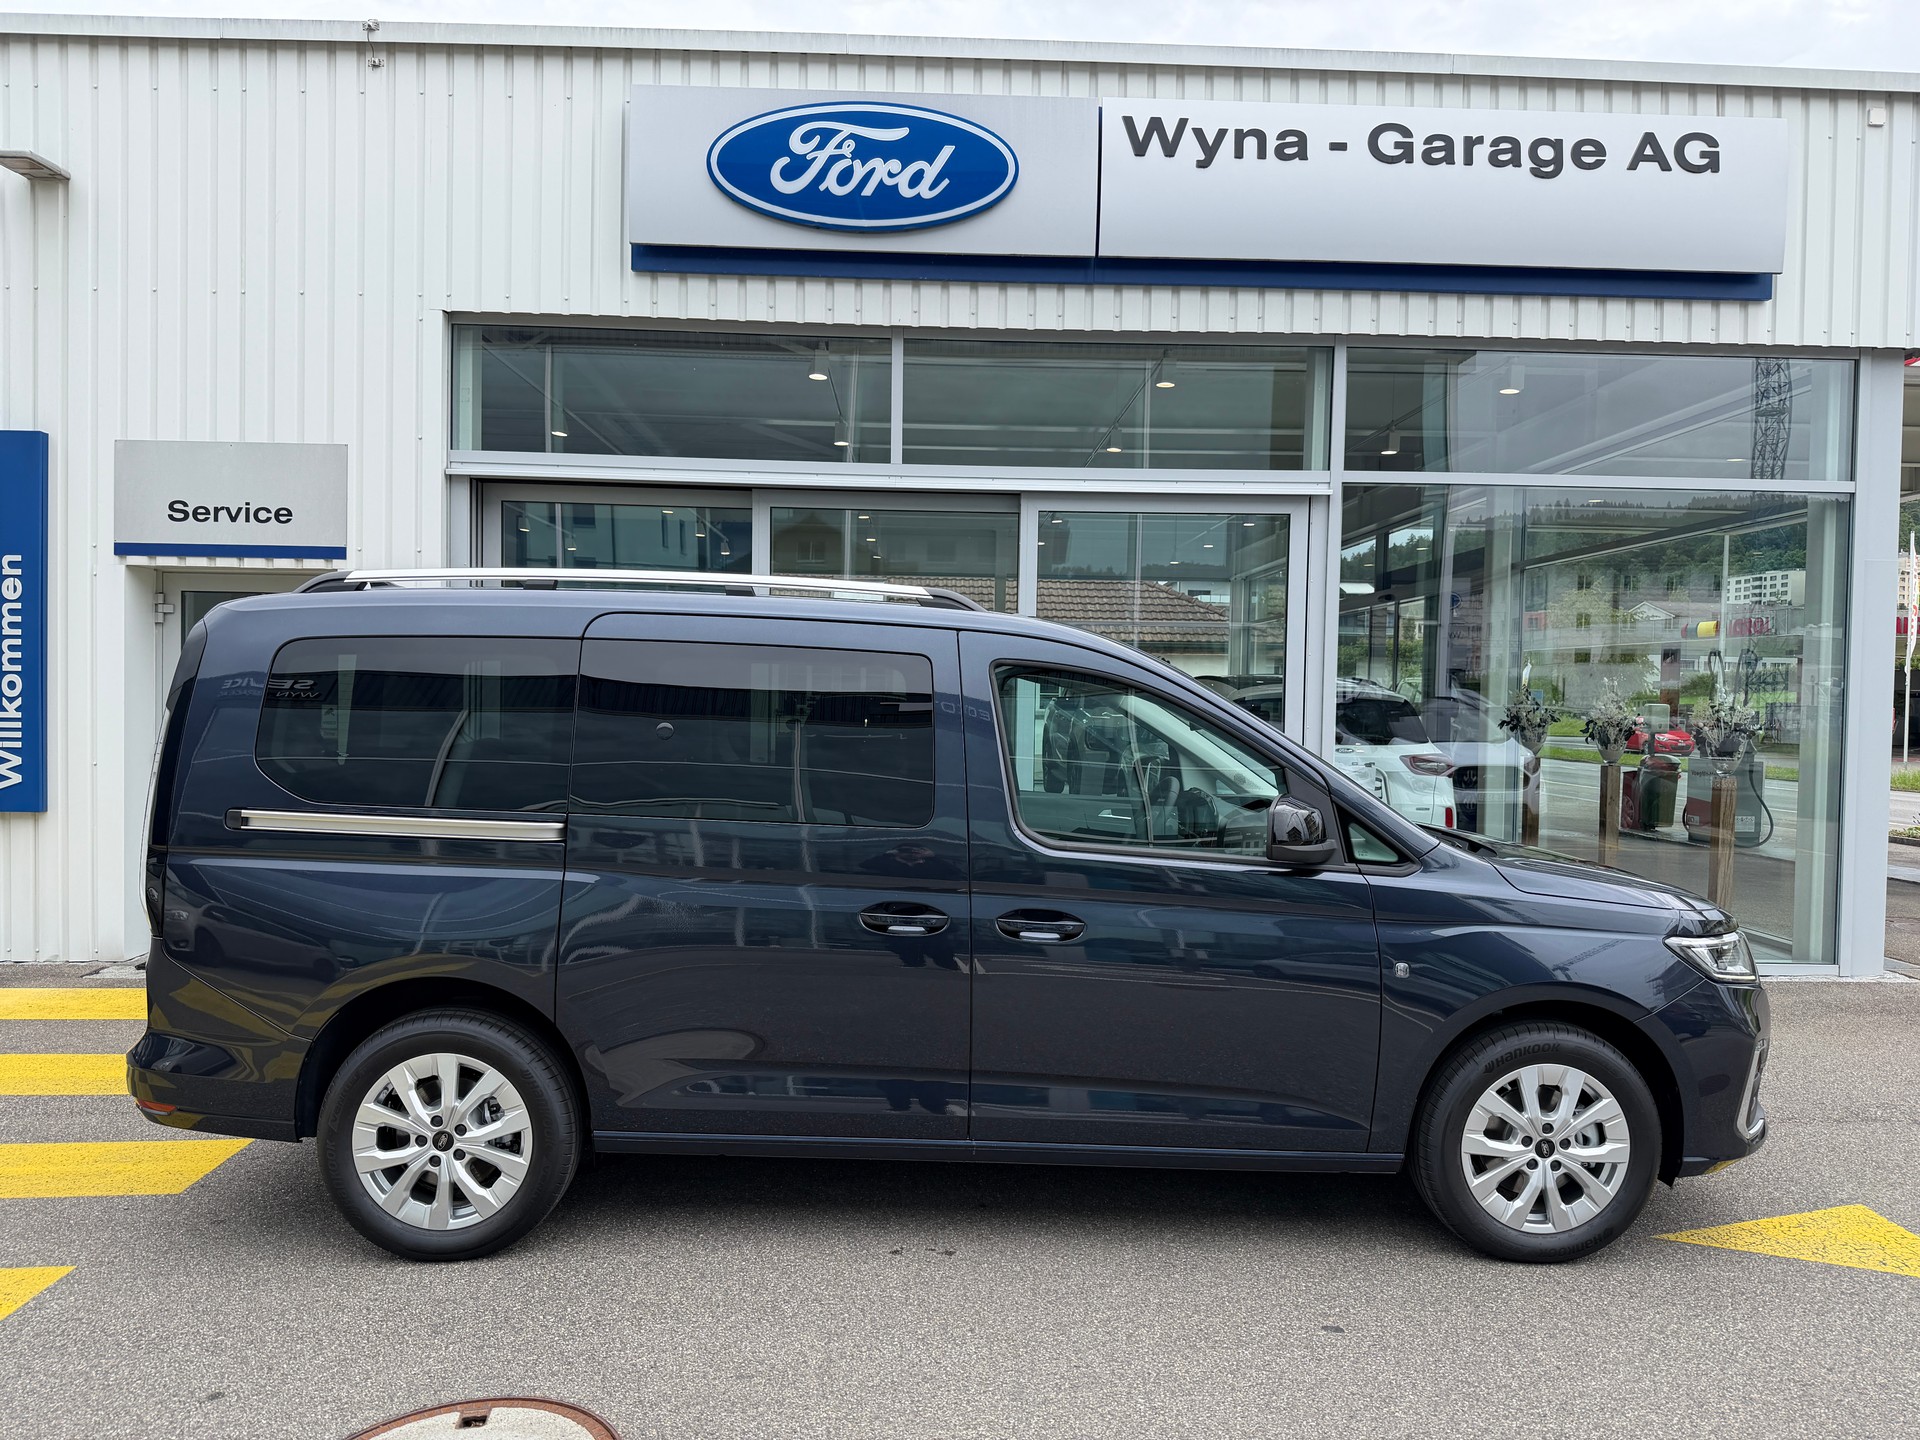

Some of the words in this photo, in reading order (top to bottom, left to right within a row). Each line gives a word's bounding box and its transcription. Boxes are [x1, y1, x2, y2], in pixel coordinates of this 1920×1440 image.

[769, 120, 955, 200] Ford
[1122, 114, 1309, 169] Wyna
[1328, 141, 1348, 152] -
[1366, 121, 1608, 180] Garage
[1626, 130, 1721, 174] AG
[167, 499, 293, 524] Service
[0, 554, 23, 790] Willkommen
